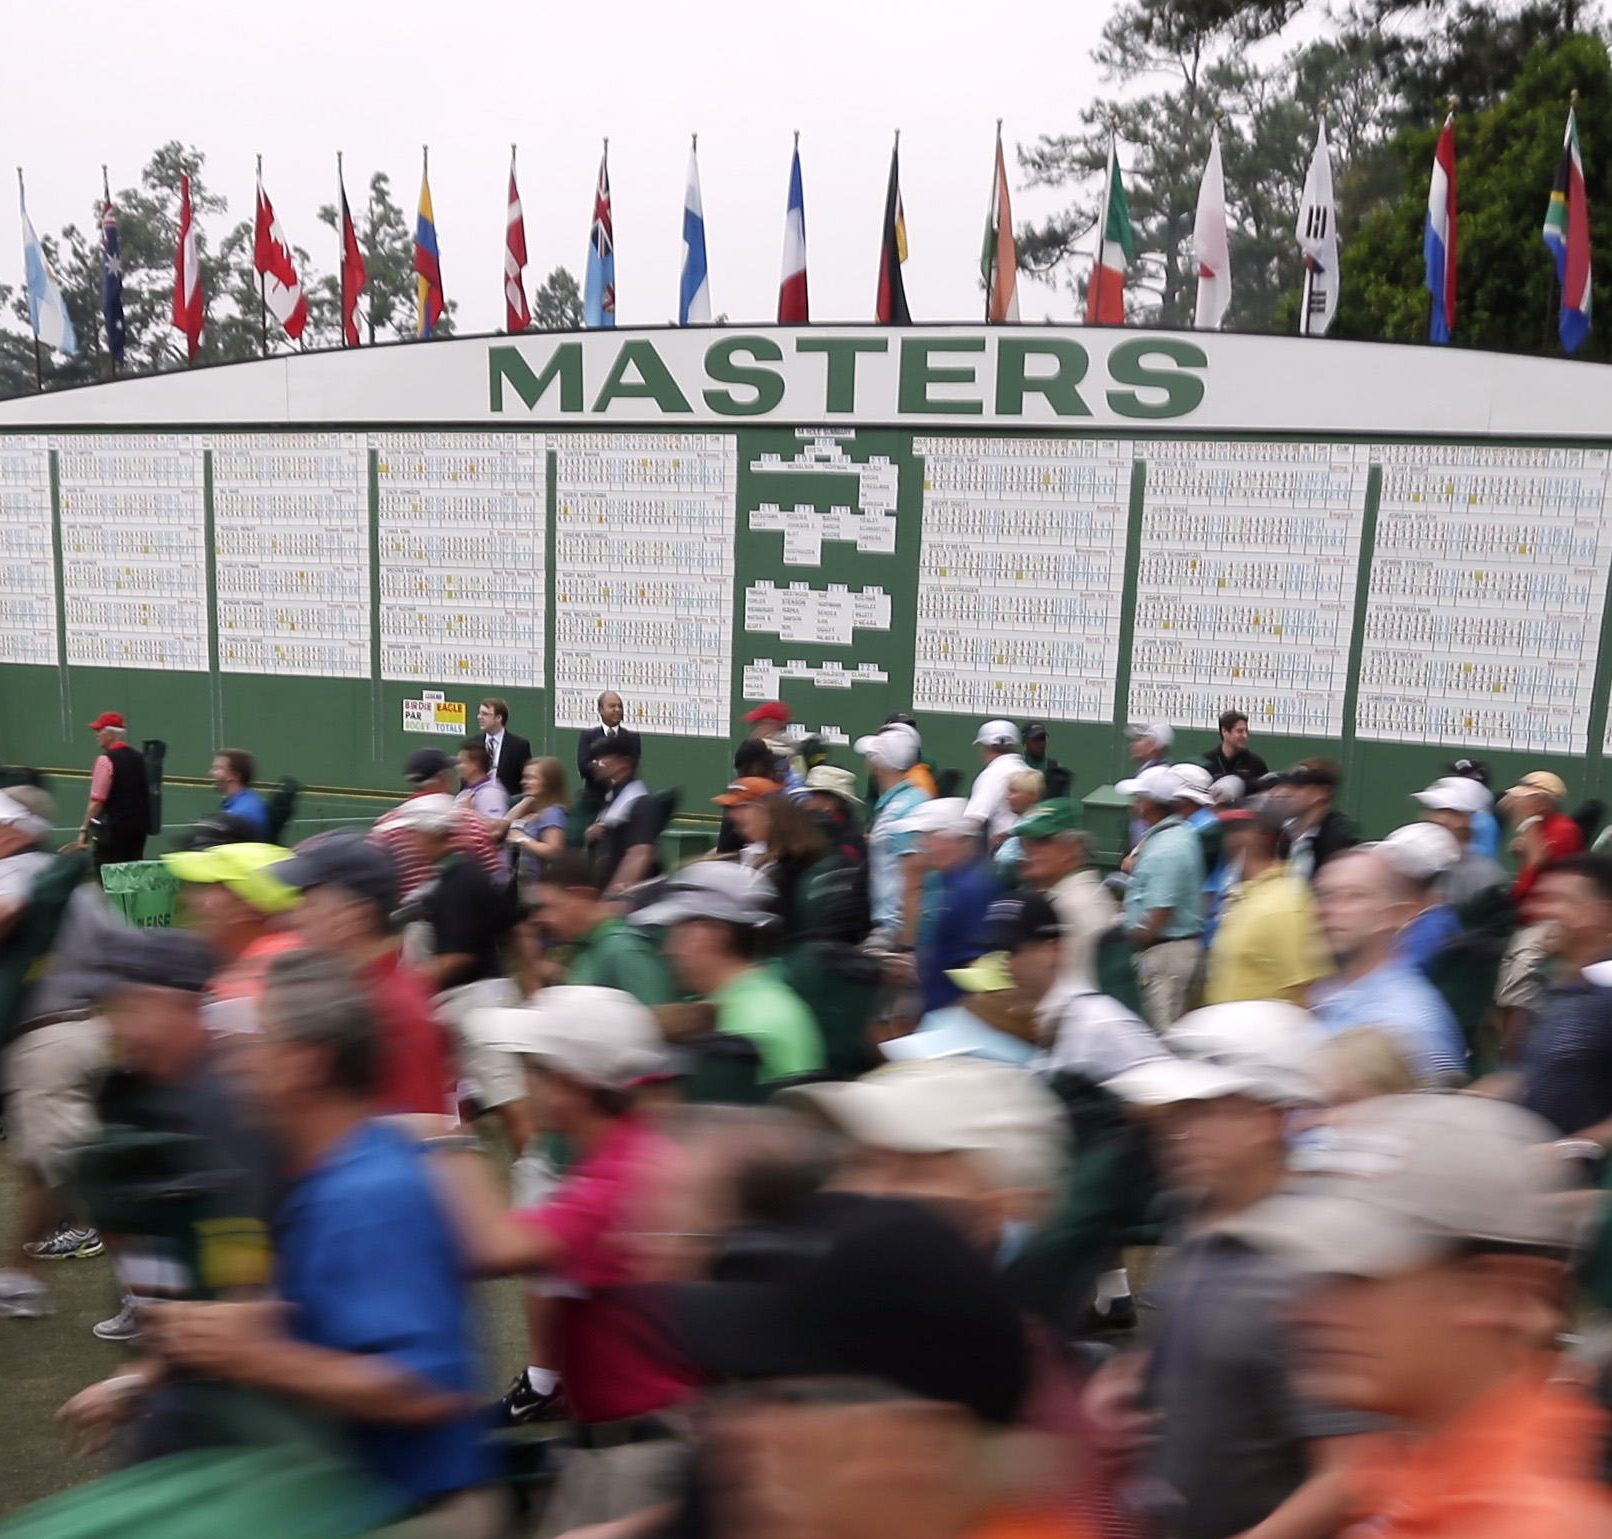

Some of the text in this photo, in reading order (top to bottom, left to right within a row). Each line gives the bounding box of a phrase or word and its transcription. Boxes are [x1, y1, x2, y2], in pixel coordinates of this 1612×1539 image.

[489, 335, 1209, 419] MASTERS
[405, 701, 431, 711] BIRDIE
[437, 703, 462, 712] EAGLE
[406, 712, 421, 720] PAR
[436, 724, 462, 732] TOTALS
